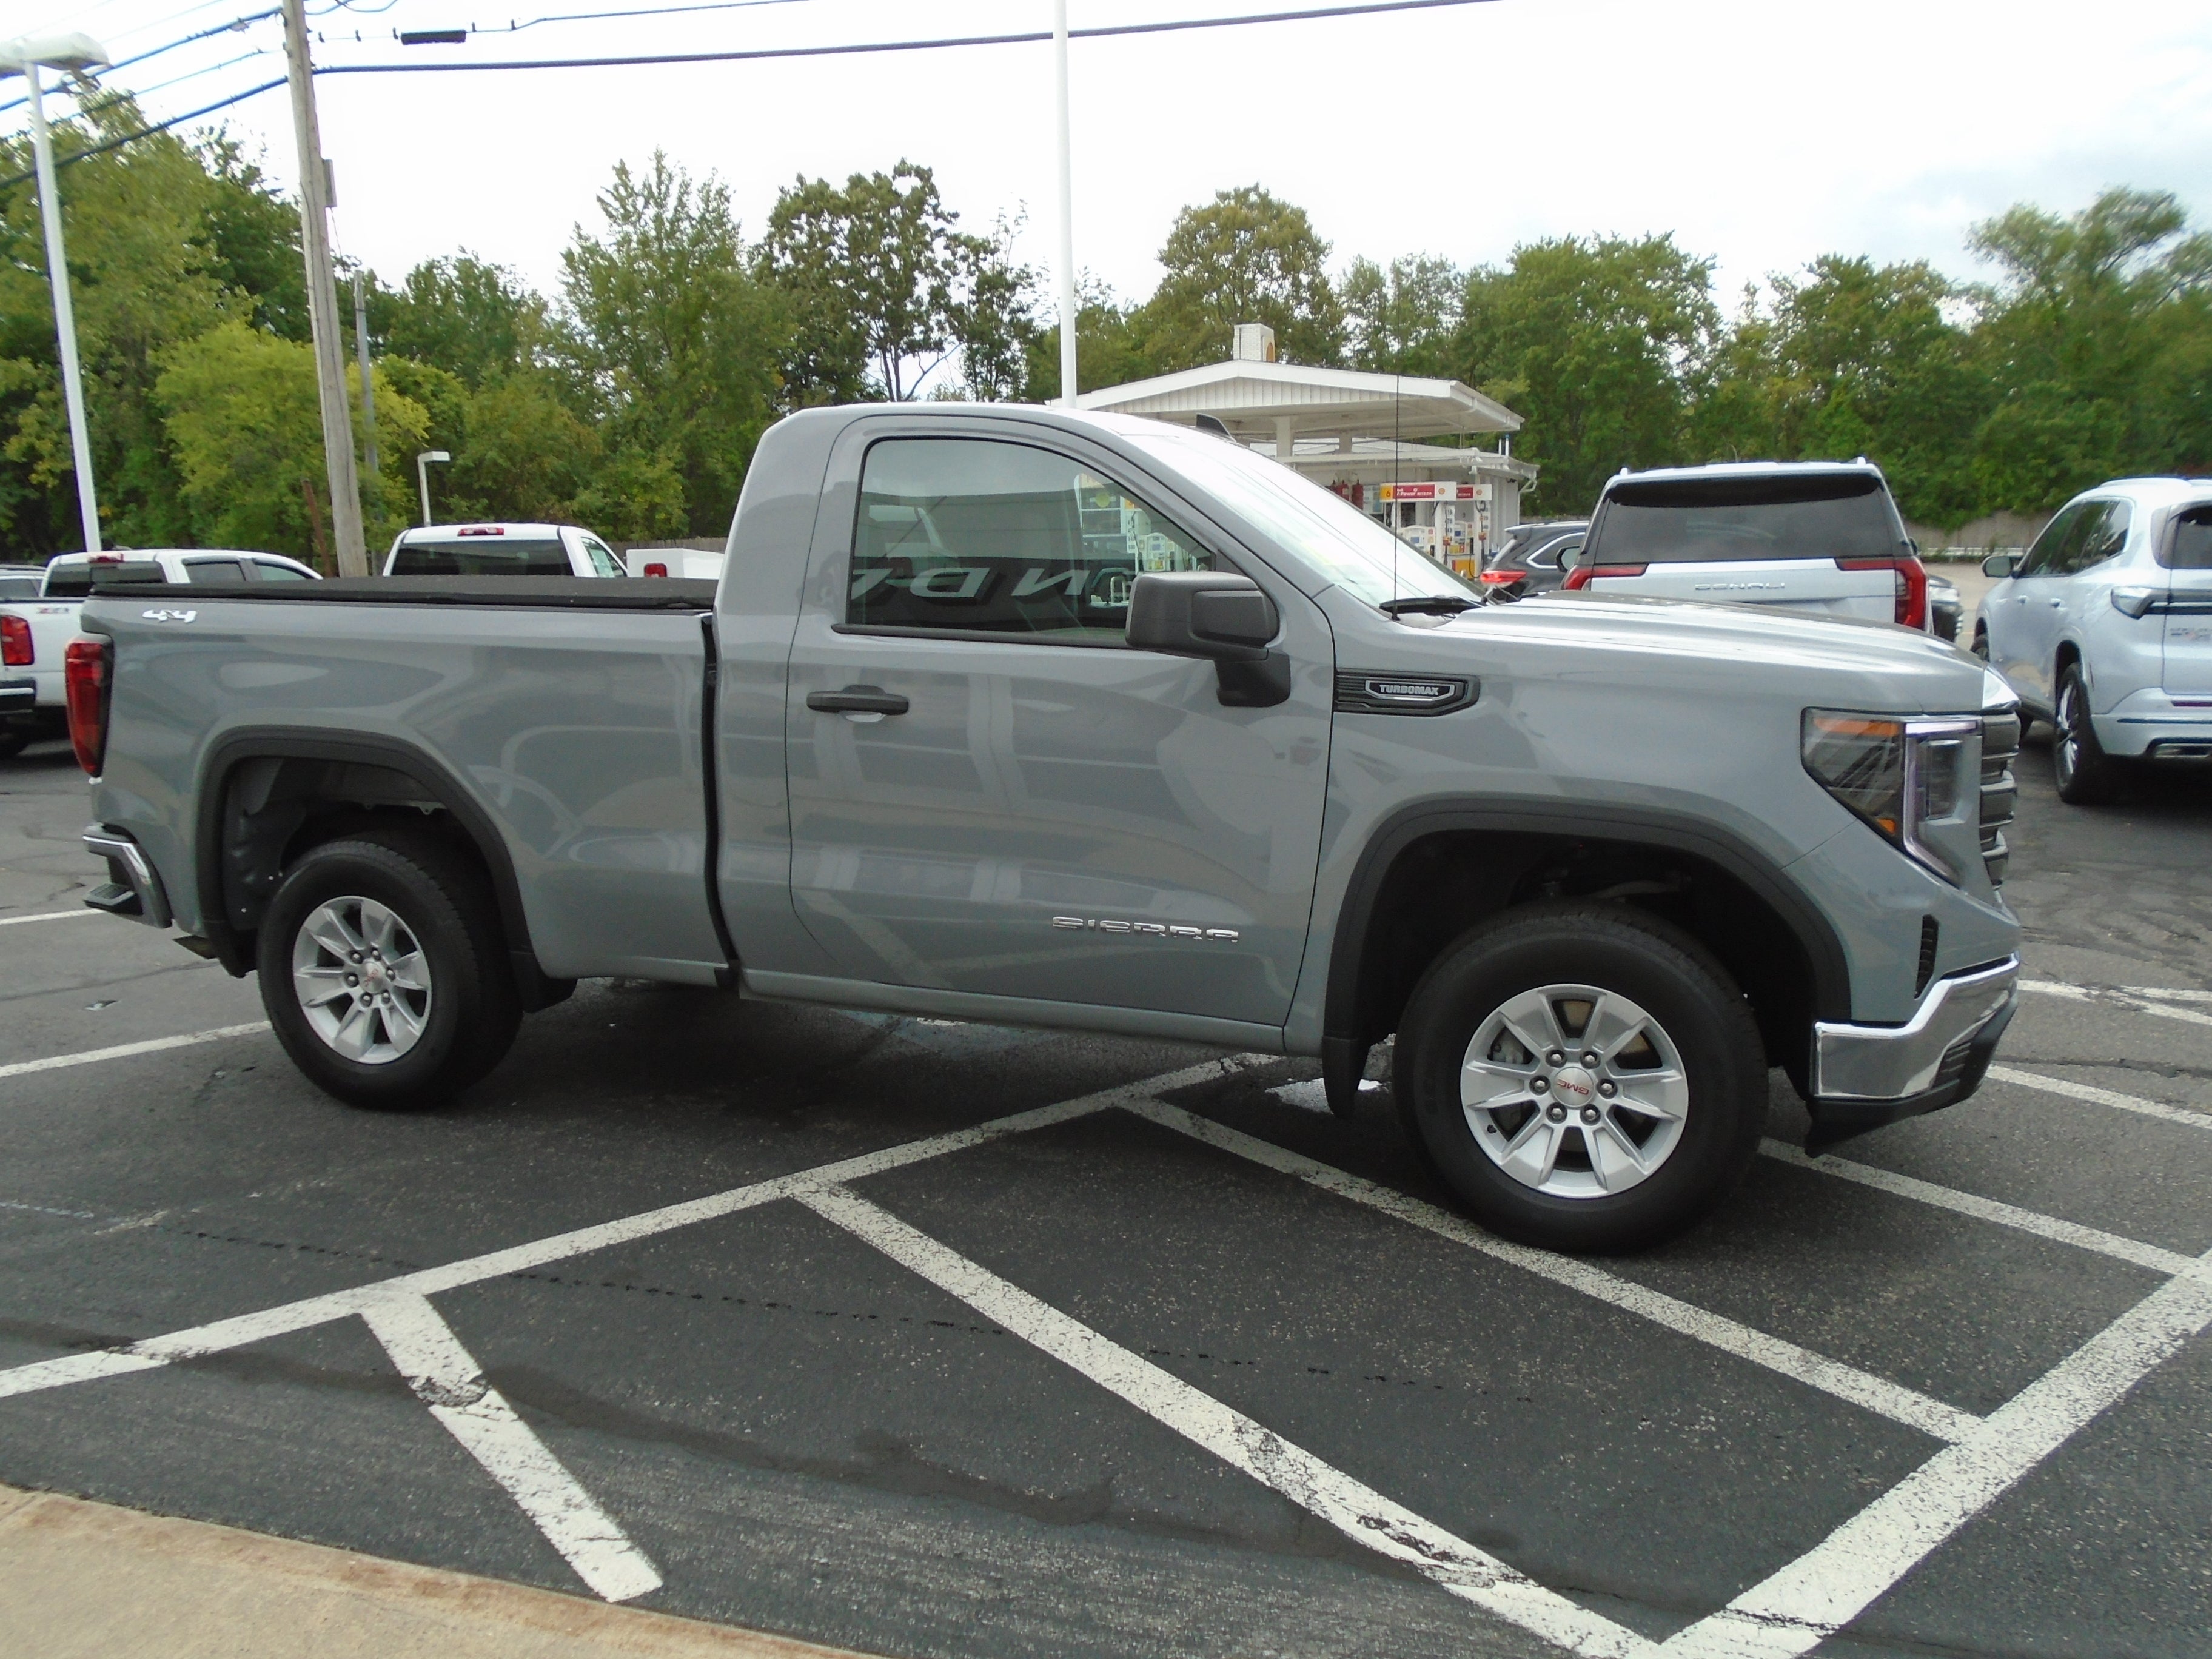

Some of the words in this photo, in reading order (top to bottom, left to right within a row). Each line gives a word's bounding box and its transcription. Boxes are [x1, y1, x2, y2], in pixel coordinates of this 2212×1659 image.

[1379, 684, 1439, 695] TURBOMAX
[1052, 916, 1239, 943] SIERRA
[1557, 1079, 1589, 1096] GMC
